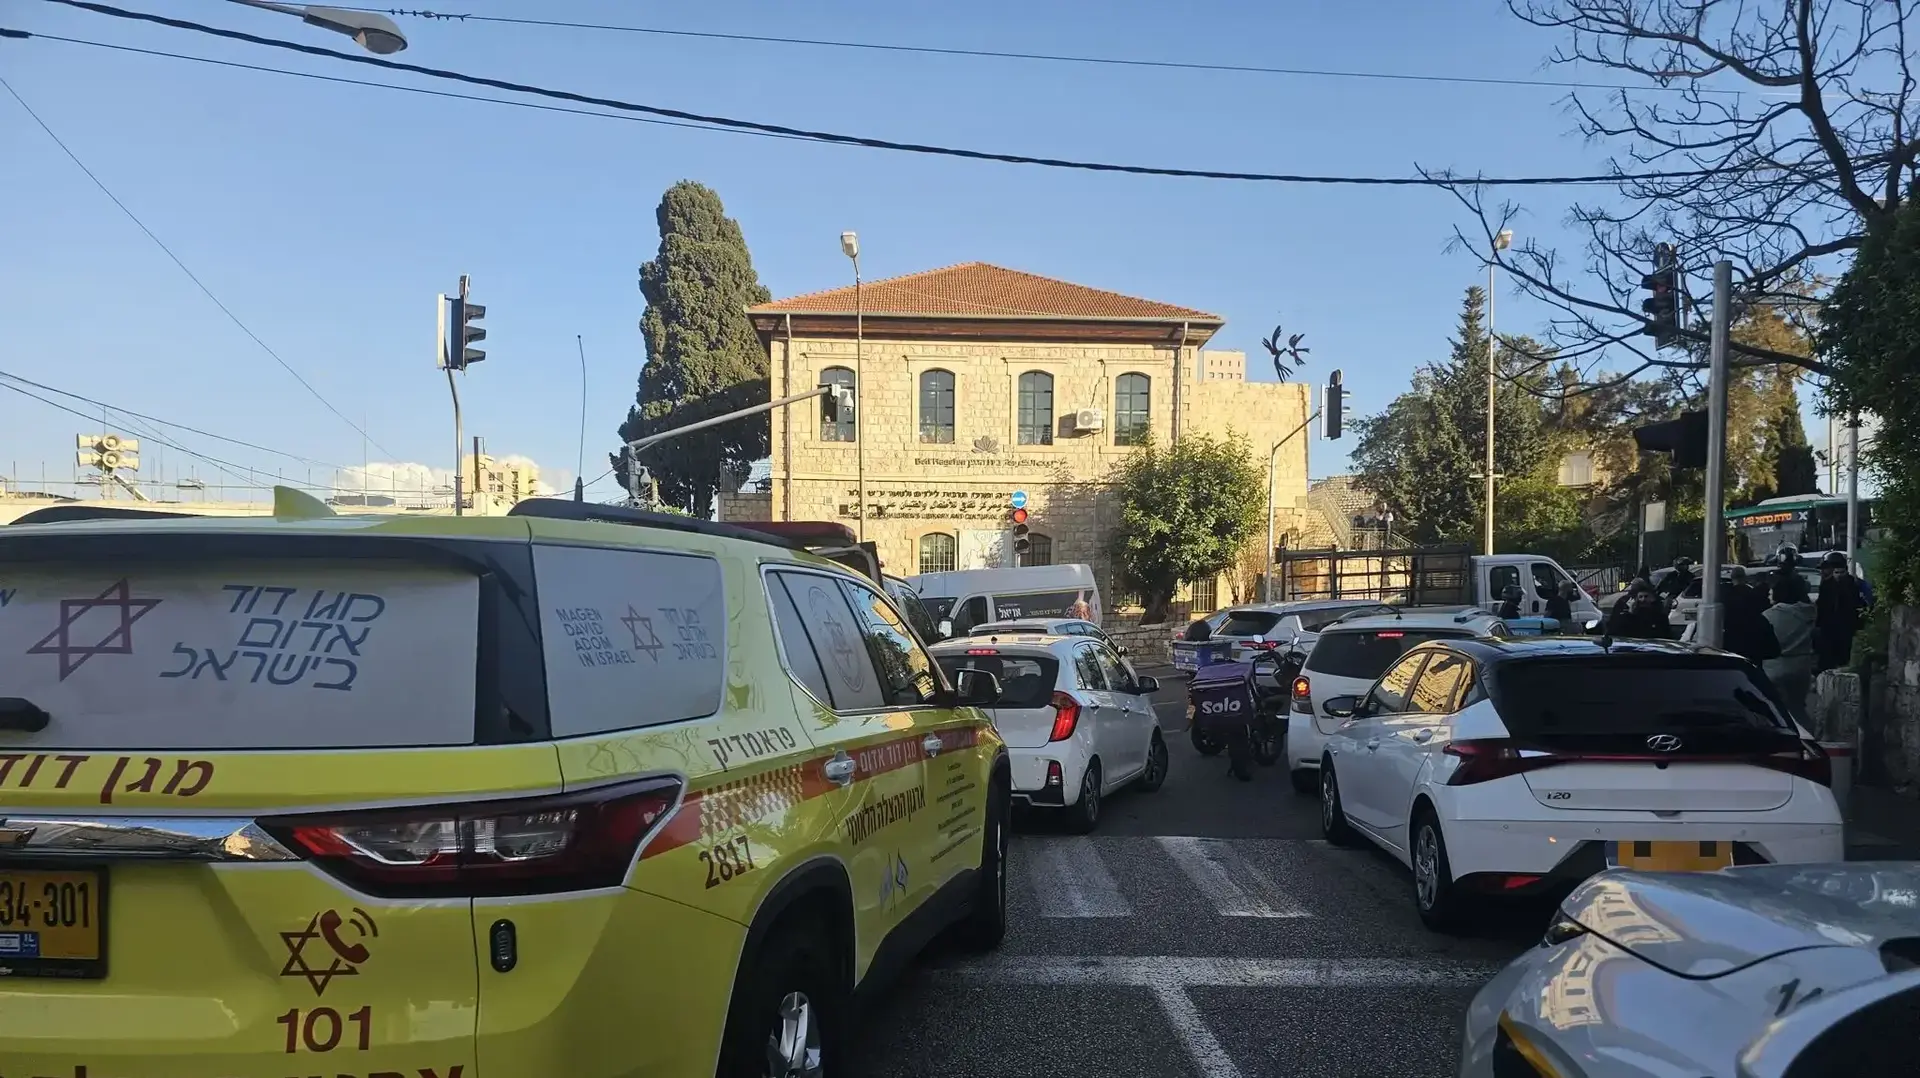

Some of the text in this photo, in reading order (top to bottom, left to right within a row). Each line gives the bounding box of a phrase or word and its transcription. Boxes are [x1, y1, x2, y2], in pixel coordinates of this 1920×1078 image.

[941, 490, 969, 499] תרבות
[222, 584, 386, 623] מגן דוד
[555, 607, 603, 622] MAGEN
[237, 617, 370, 656] אדום
[563, 622, 604, 637] DAVID
[574, 636, 613, 651] ADOM
[159, 641, 358, 692] בישראל
[578, 650, 636, 667] IN ISRAEL
[707, 726, 798, 773] פראמדיק
[860, 747, 886, 773] אדום
[887, 743, 902, 765] דוד
[903, 740, 917, 766] מגן
[0, 754, 215, 804] מגן דוד
[876, 792, 907, 829] ההצלה
[906, 784, 927, 823] ארגון
[845, 801, 877, 847] הלאומי
[698, 835, 755, 890] 2817
[24, 933, 35, 942] IL
[276, 1005, 372, 1053] 101
